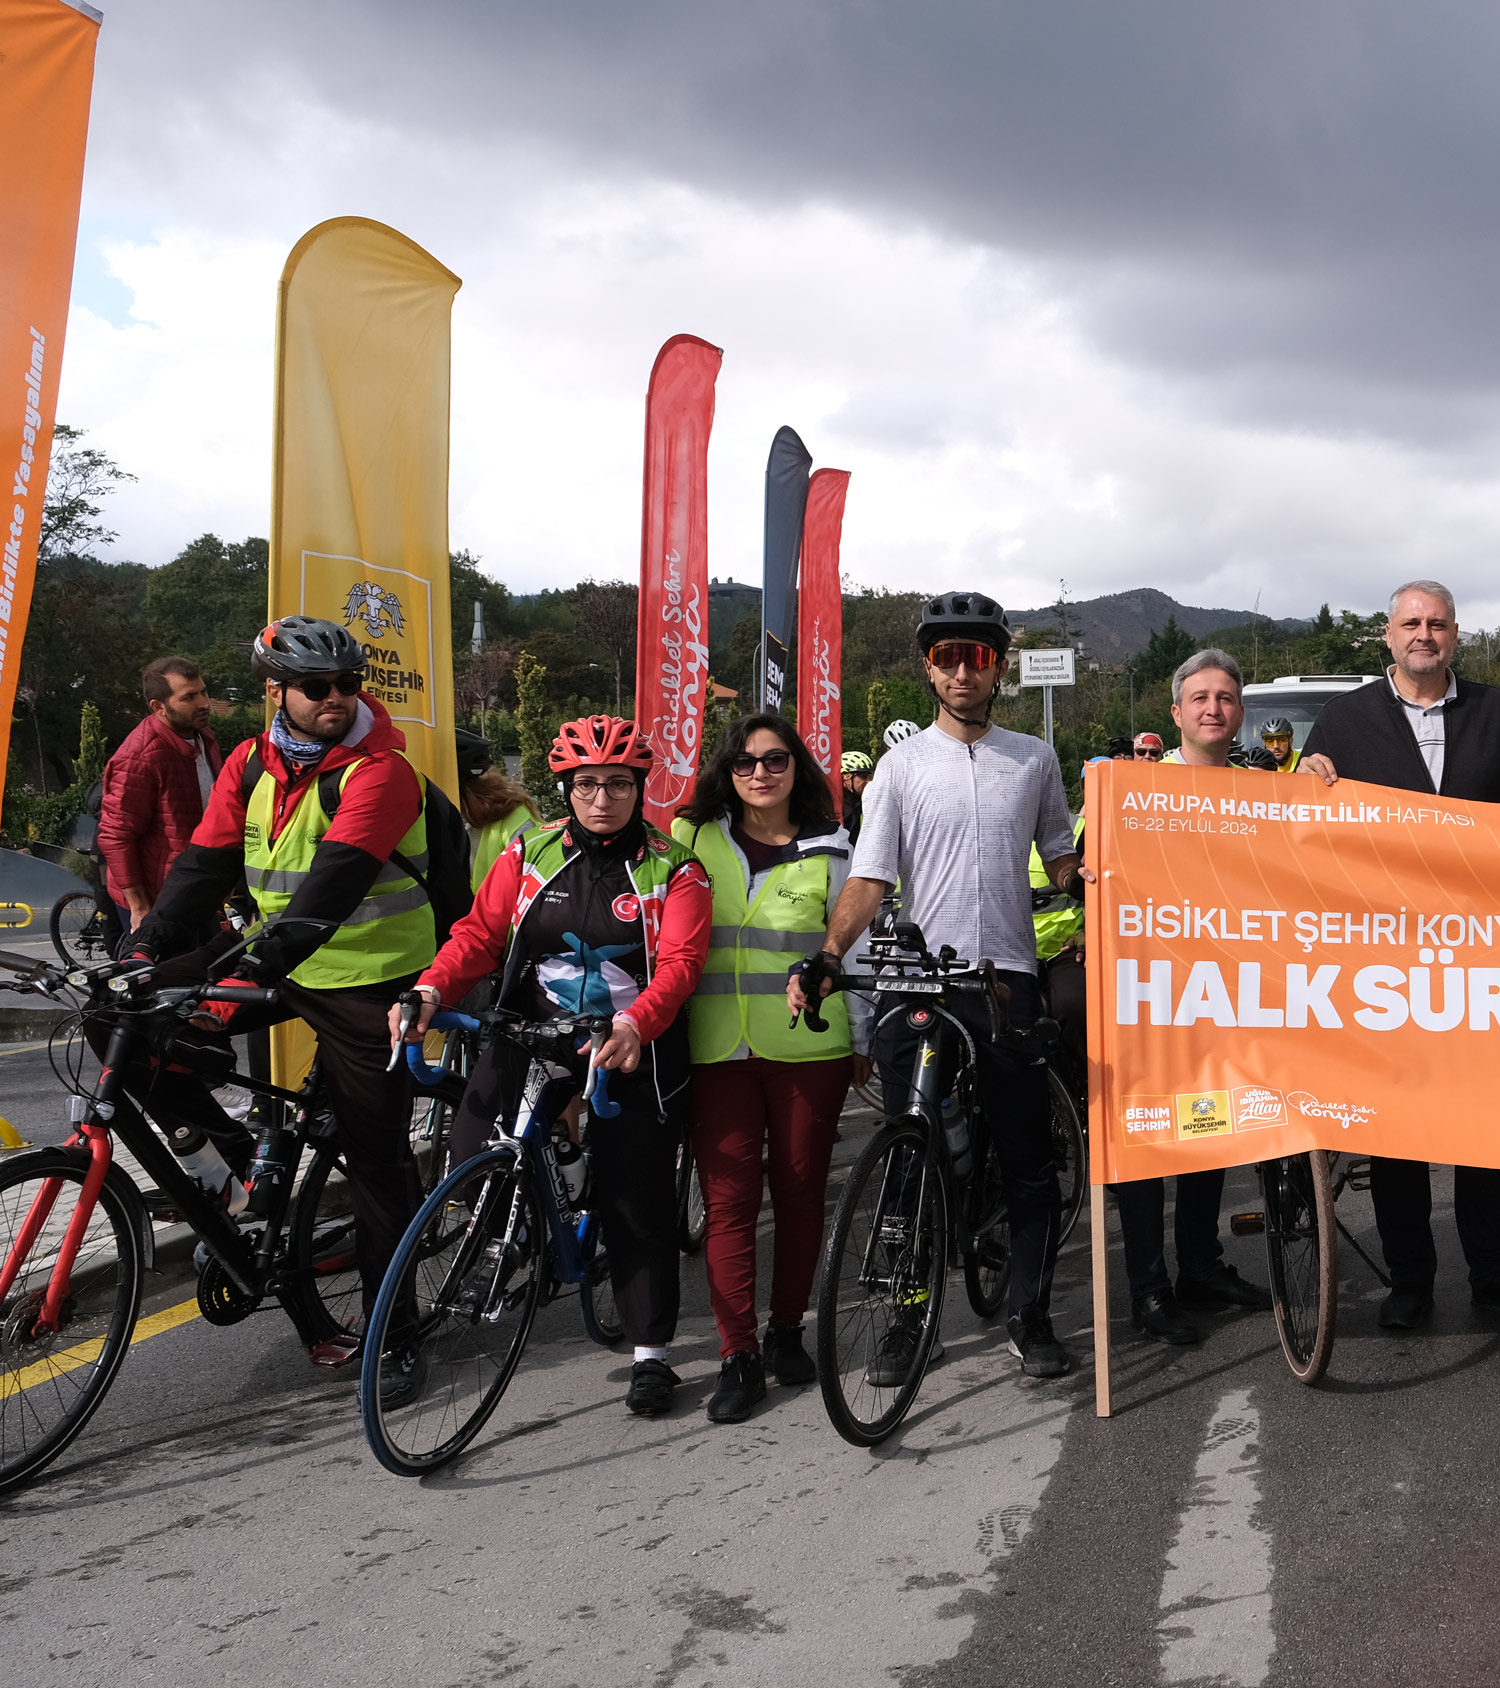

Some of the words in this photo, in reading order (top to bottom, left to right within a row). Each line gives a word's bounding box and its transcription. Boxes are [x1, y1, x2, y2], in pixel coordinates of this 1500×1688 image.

[0, 508, 25, 623] Birlikte
[13, 326, 47, 498] Yaşayalım!
[359, 643, 401, 665] ONYA
[669, 582, 709, 778] Konya
[812, 639, 840, 775] Konya
[1122, 791, 1216, 815] AVRUPA
[1220, 797, 1382, 824] HAREKETLİLİK
[1386, 806, 1476, 827] HAFTASI
[1122, 816, 1165, 832] 16-22
[1168, 817, 1217, 834] EYLÜL
[1220, 820, 1258, 836] 2024
[1118, 898, 1286, 942] BİSİKLET
[1294, 906, 1406, 953] ŞEHRİ
[1116, 958, 1344, 1029] HALK
[1126, 1107, 1170, 1120] BENİM
[1299, 1100, 1368, 1129] Konya
[504, 1184, 522, 1244] SCOTT
